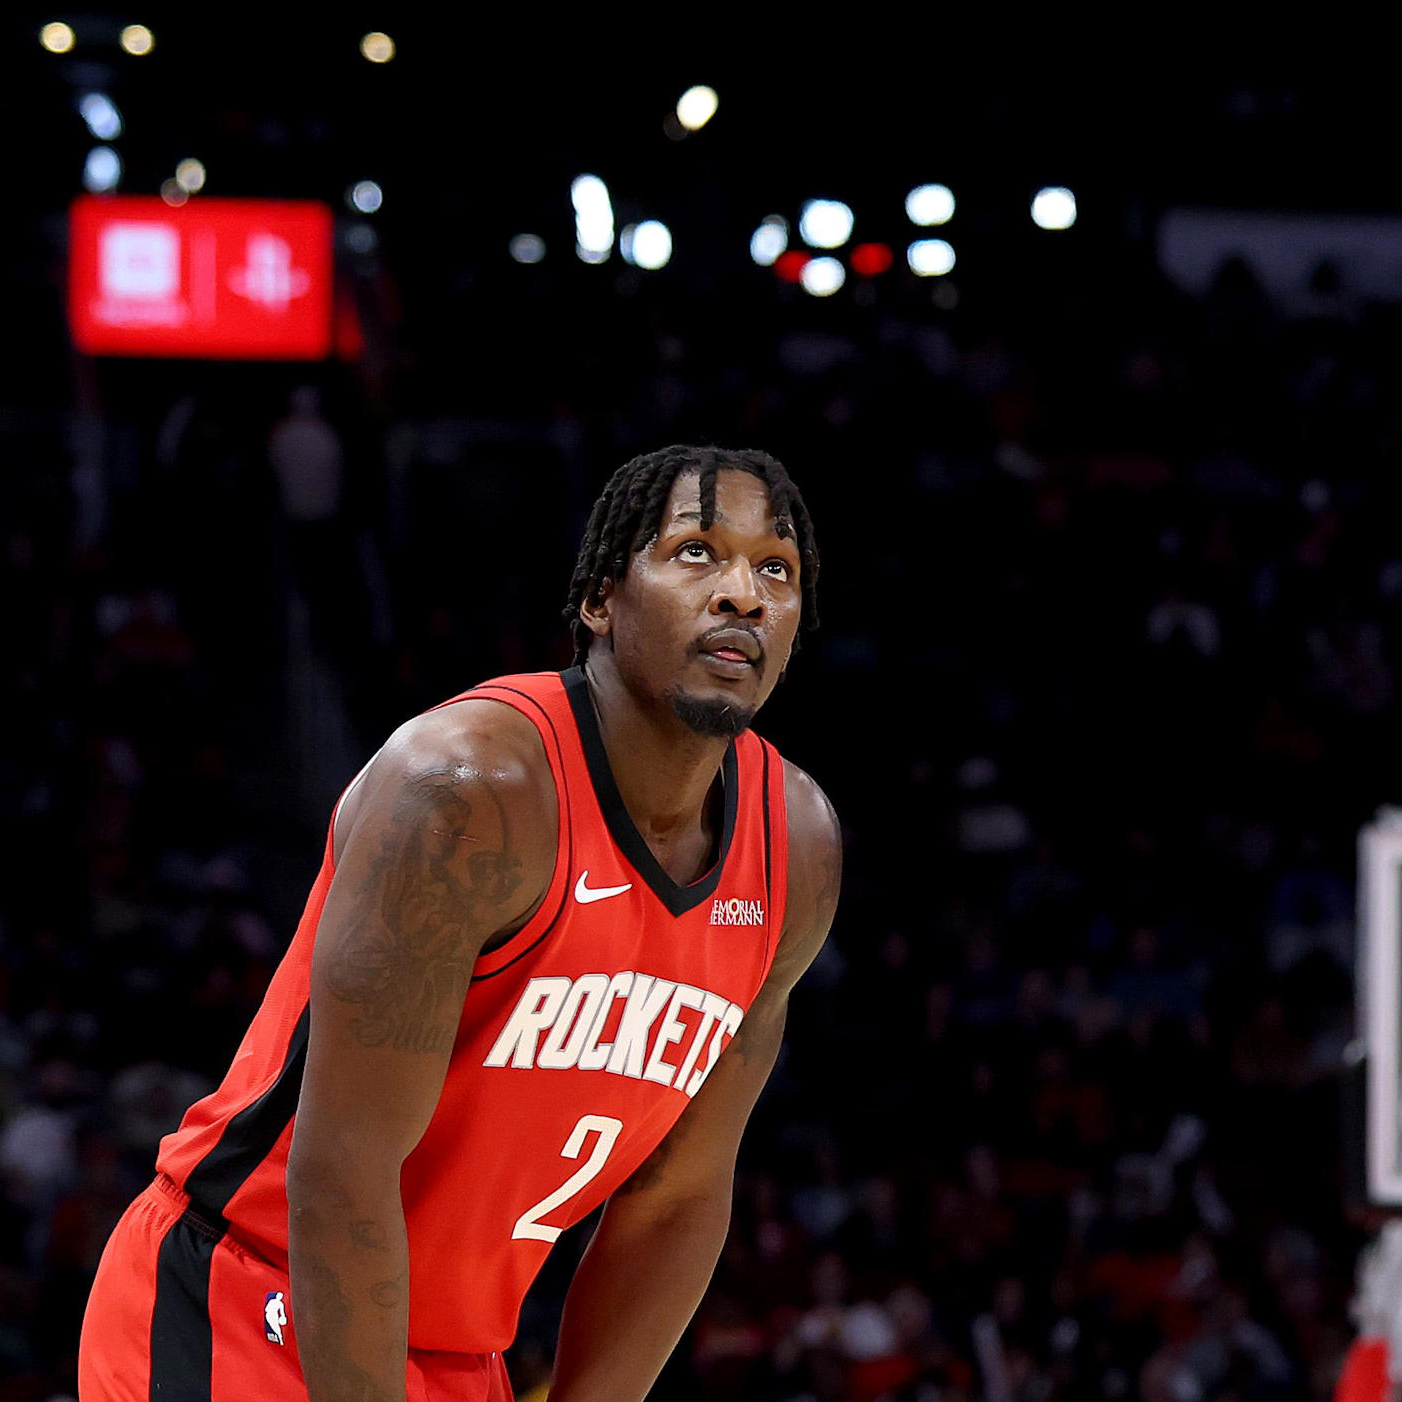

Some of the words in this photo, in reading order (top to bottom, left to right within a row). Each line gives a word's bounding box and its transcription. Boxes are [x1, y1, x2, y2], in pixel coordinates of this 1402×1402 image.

[712, 898, 764, 914] EMORIAL
[482, 971, 745, 1099] ROCKETS
[511, 1114, 623, 1244] 2
